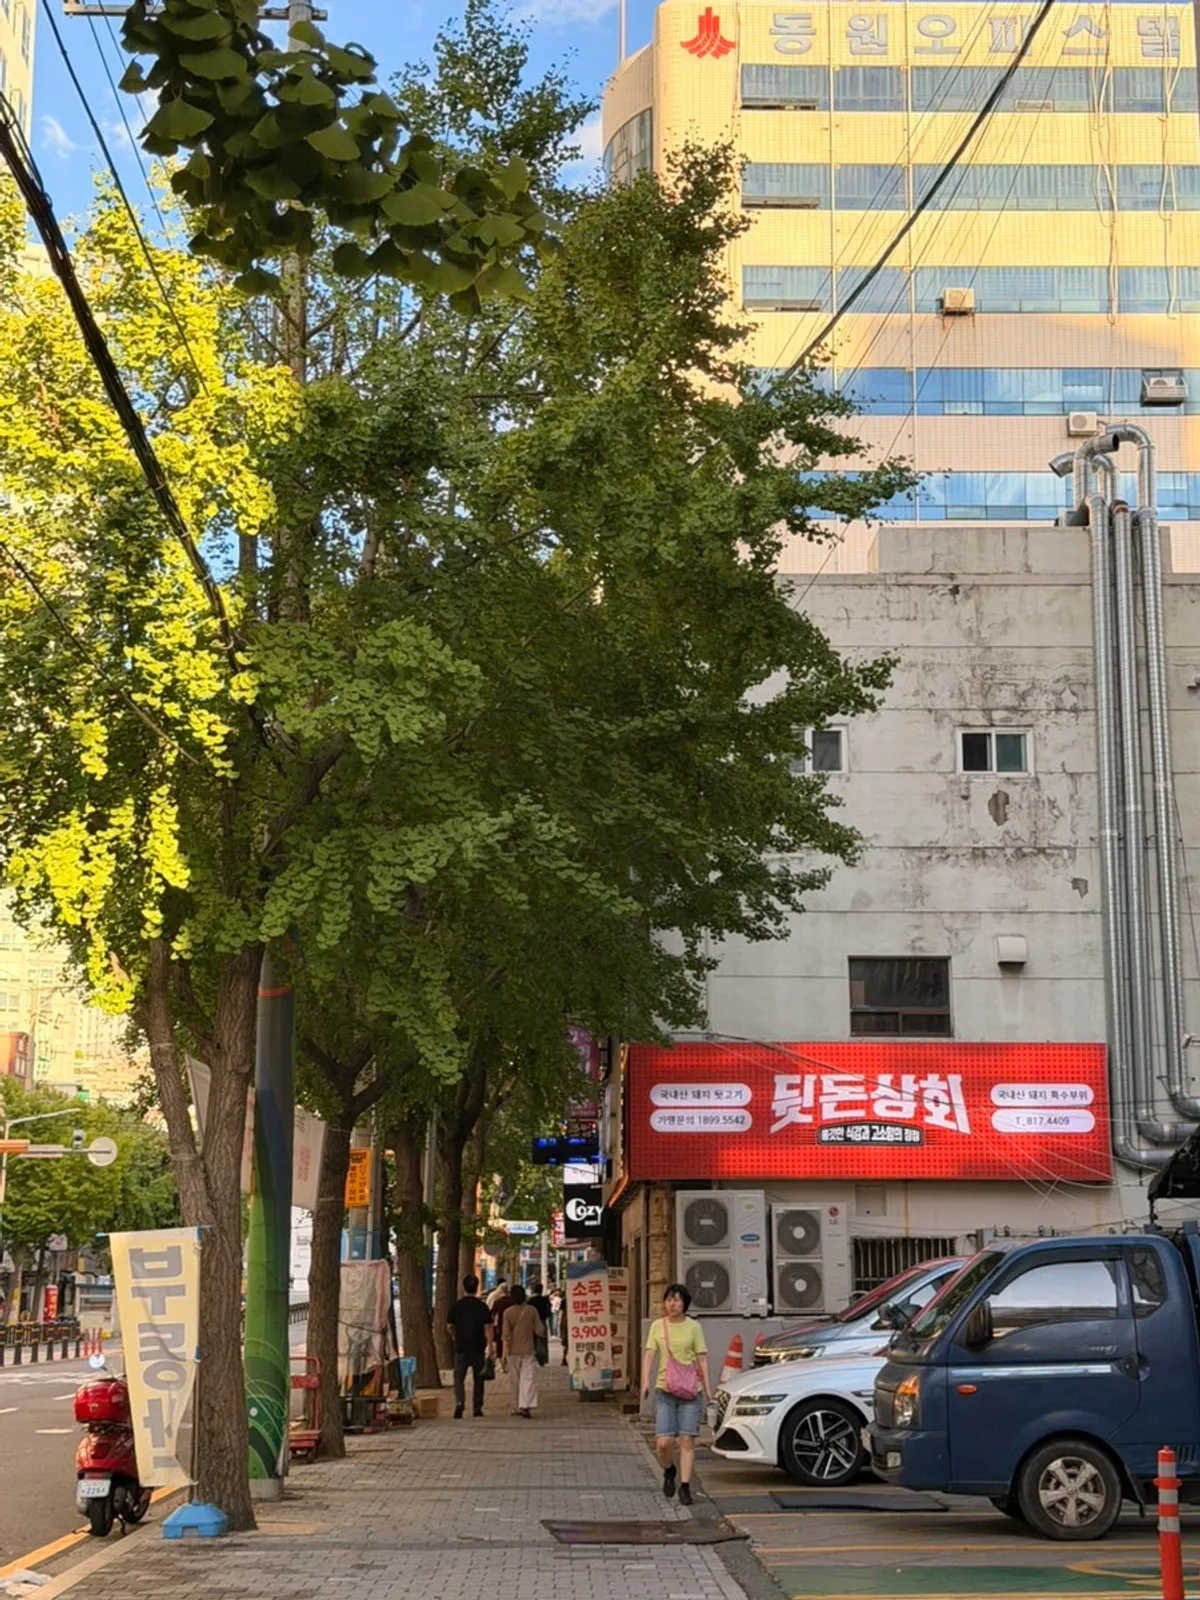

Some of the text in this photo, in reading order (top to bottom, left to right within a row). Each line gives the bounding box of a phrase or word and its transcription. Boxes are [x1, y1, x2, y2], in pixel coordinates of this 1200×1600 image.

[769, 13, 1180, 58] 동원오피스텔
[660, 1089, 688, 1100] 국내산
[692, 1089, 711, 1100] 돼지
[997, 1089, 1025, 1101] 국내산
[1028, 1089, 1047, 1101] 돼지
[770, 1073, 971, 1135] 뒷돈상회
[658, 1114, 746, 1126] 가맹문의 1899.5542
[572, 1280, 603, 1297] 소주
[573, 1300, 604, 1316] 맥주
[571, 1325, 607, 1339] 3,900
